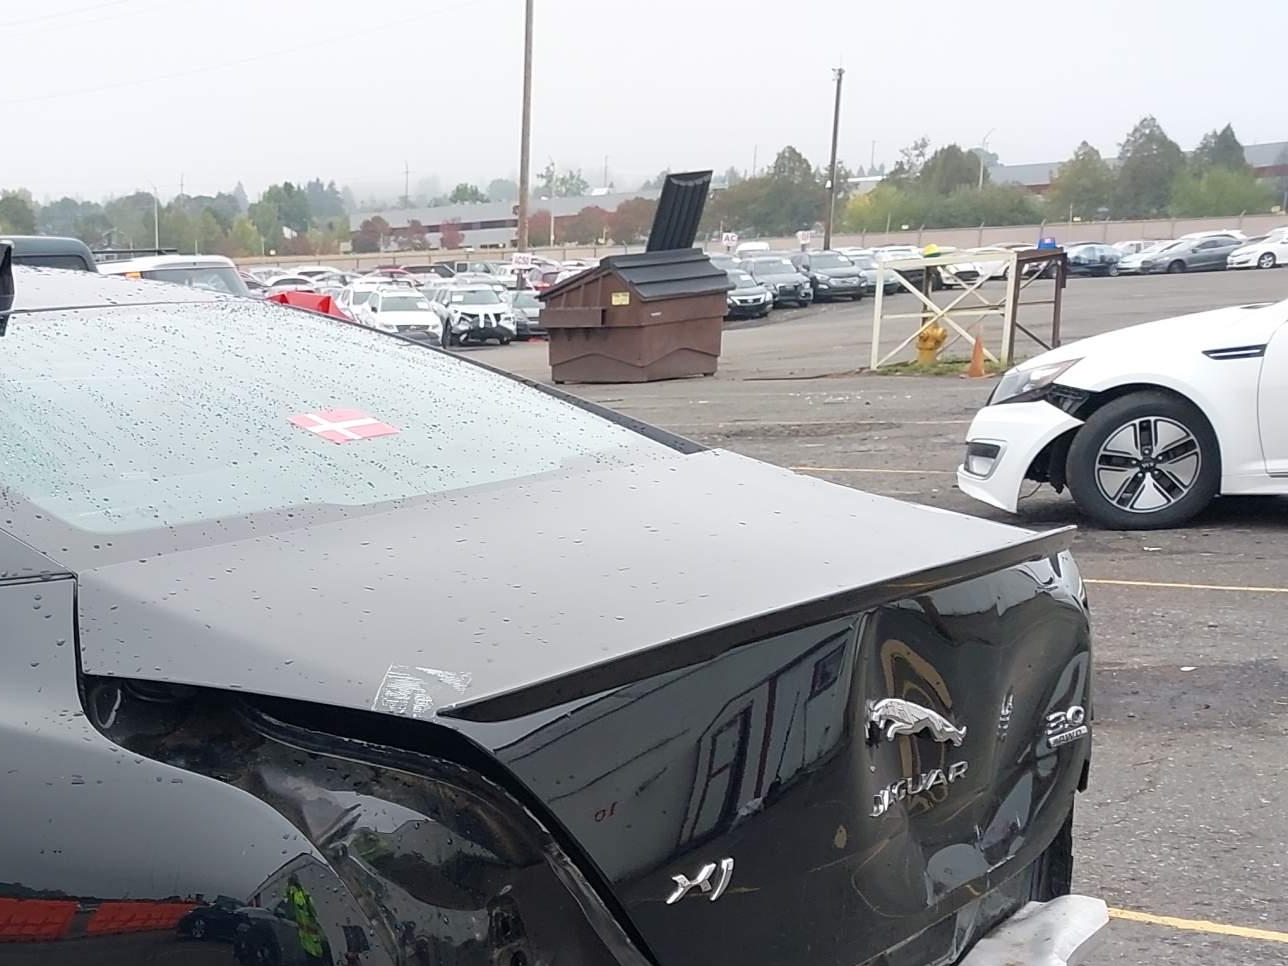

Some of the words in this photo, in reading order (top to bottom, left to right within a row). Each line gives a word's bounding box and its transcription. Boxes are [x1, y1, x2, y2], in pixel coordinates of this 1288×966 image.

[1045, 705, 1085, 735] 3.0
[869, 761, 968, 817] JAGUAR
[665, 857, 734, 905] XJ
